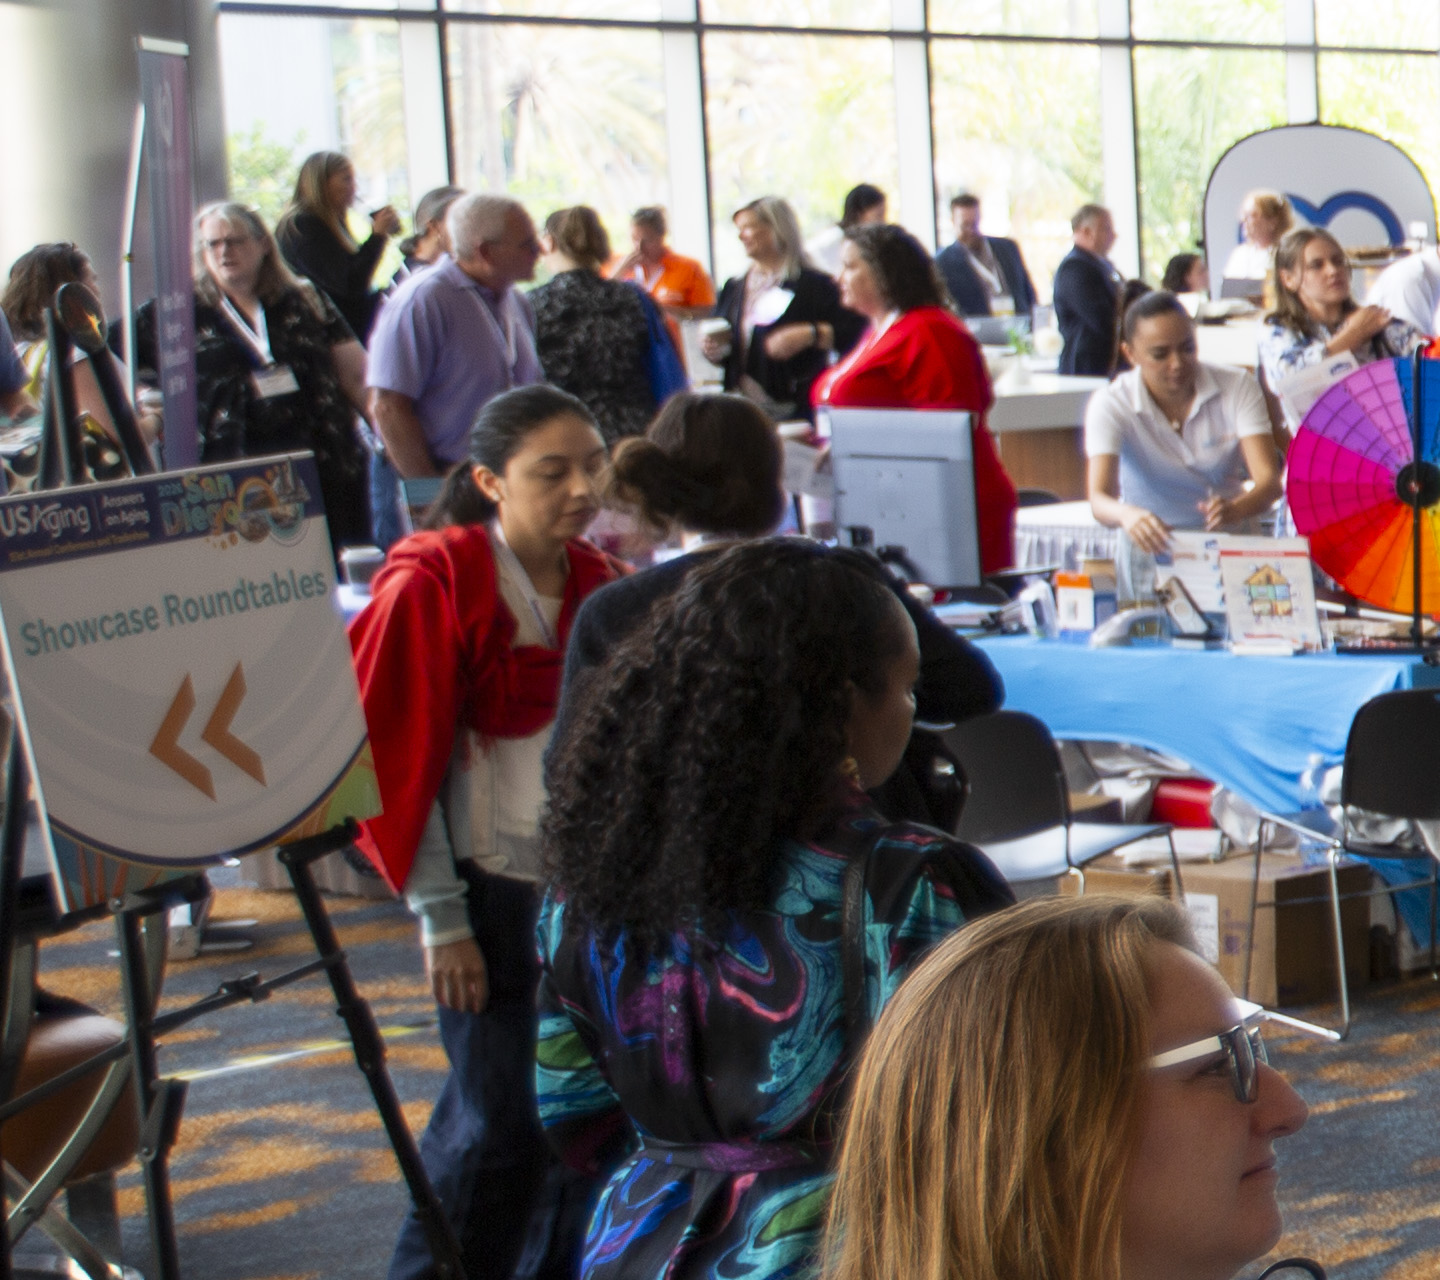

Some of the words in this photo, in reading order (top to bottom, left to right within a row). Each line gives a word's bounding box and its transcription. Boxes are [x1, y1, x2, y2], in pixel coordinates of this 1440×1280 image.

[183, 472, 236, 504] San
[0, 502, 91, 539] USAging
[160, 498, 240, 537] Diego
[19, 604, 161, 658] Showcase
[163, 569, 329, 629] Roundtables
